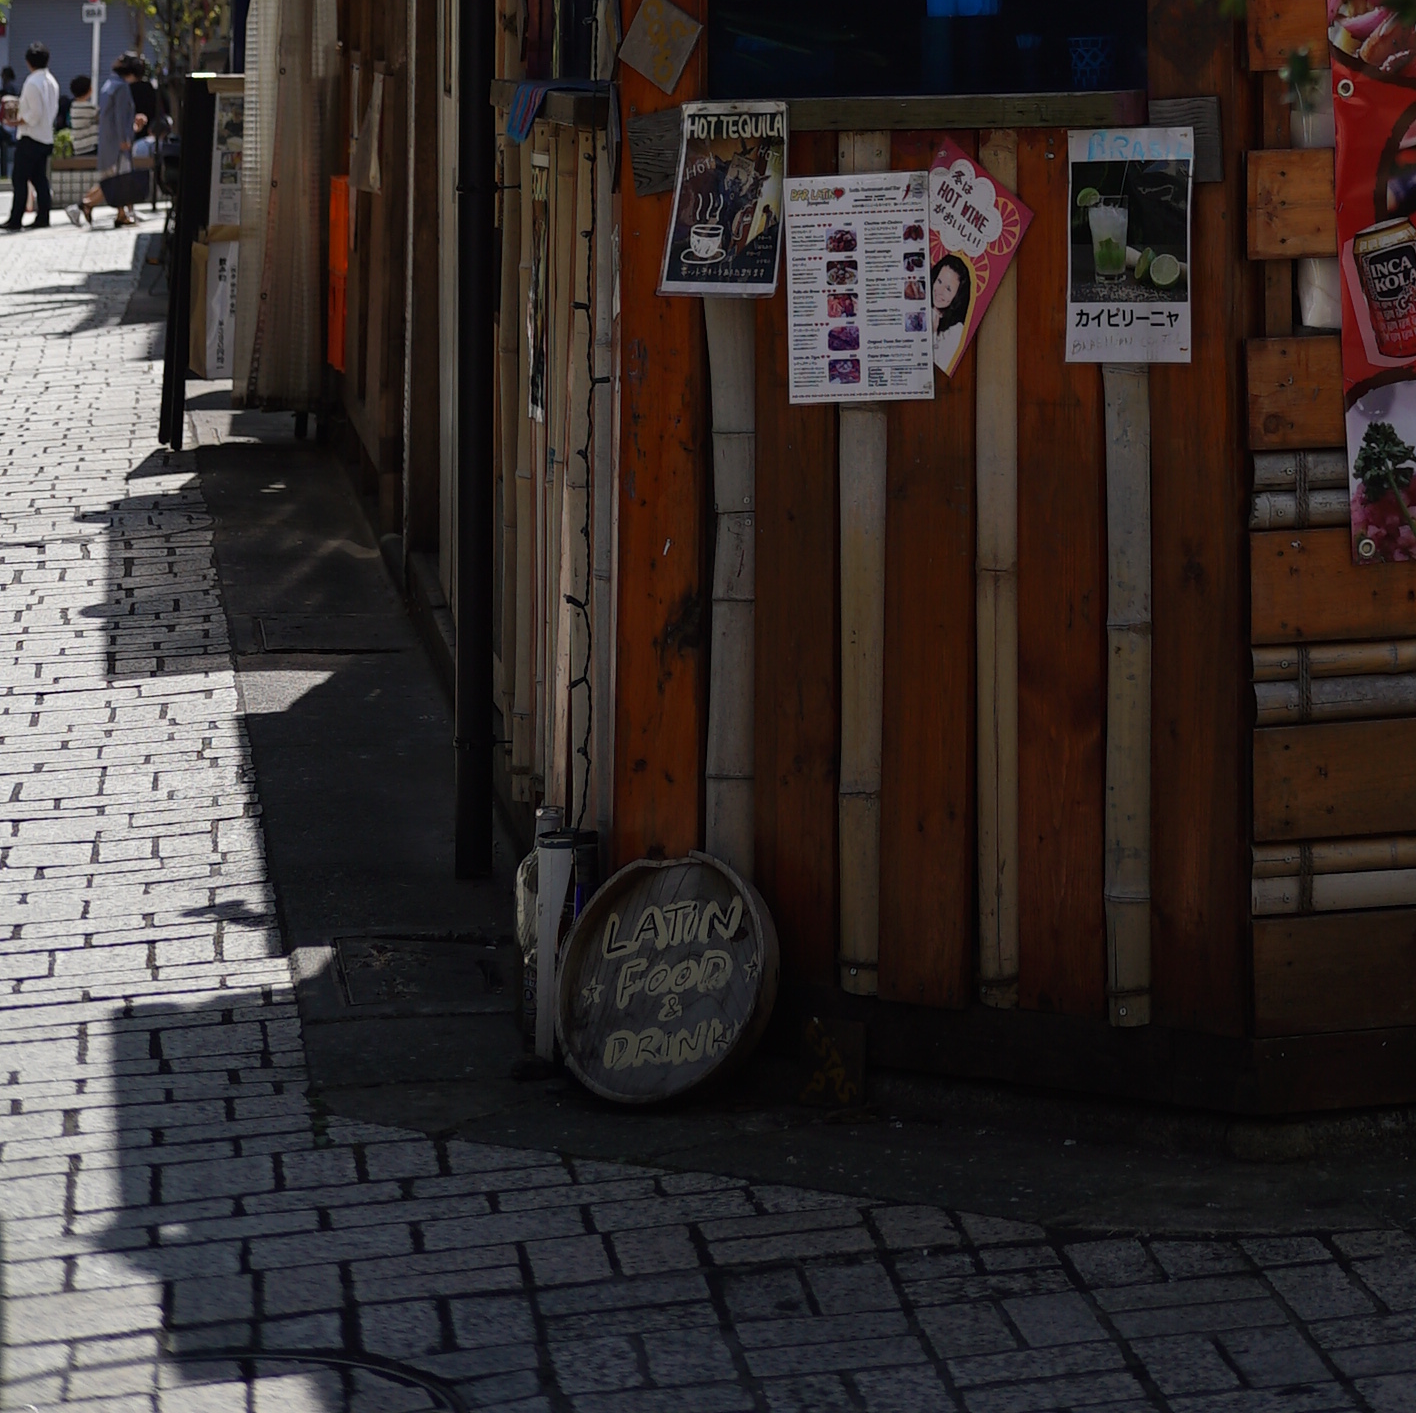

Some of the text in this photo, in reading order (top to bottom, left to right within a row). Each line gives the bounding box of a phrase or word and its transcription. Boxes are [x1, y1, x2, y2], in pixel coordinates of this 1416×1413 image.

[686, 115, 718, 141] HOT
[1087, 130, 1193, 164] BRASIL
[952, 169, 974, 195] 冬は
[937, 181, 962, 209] HOT
[961, 200, 990, 234] WINE
[1370, 254, 1413, 279] INCA
[1075, 308, 1180, 328] カイピリーニャ
[616, 949, 733, 1010] FOOD
[657, 993, 683, 1022] &
